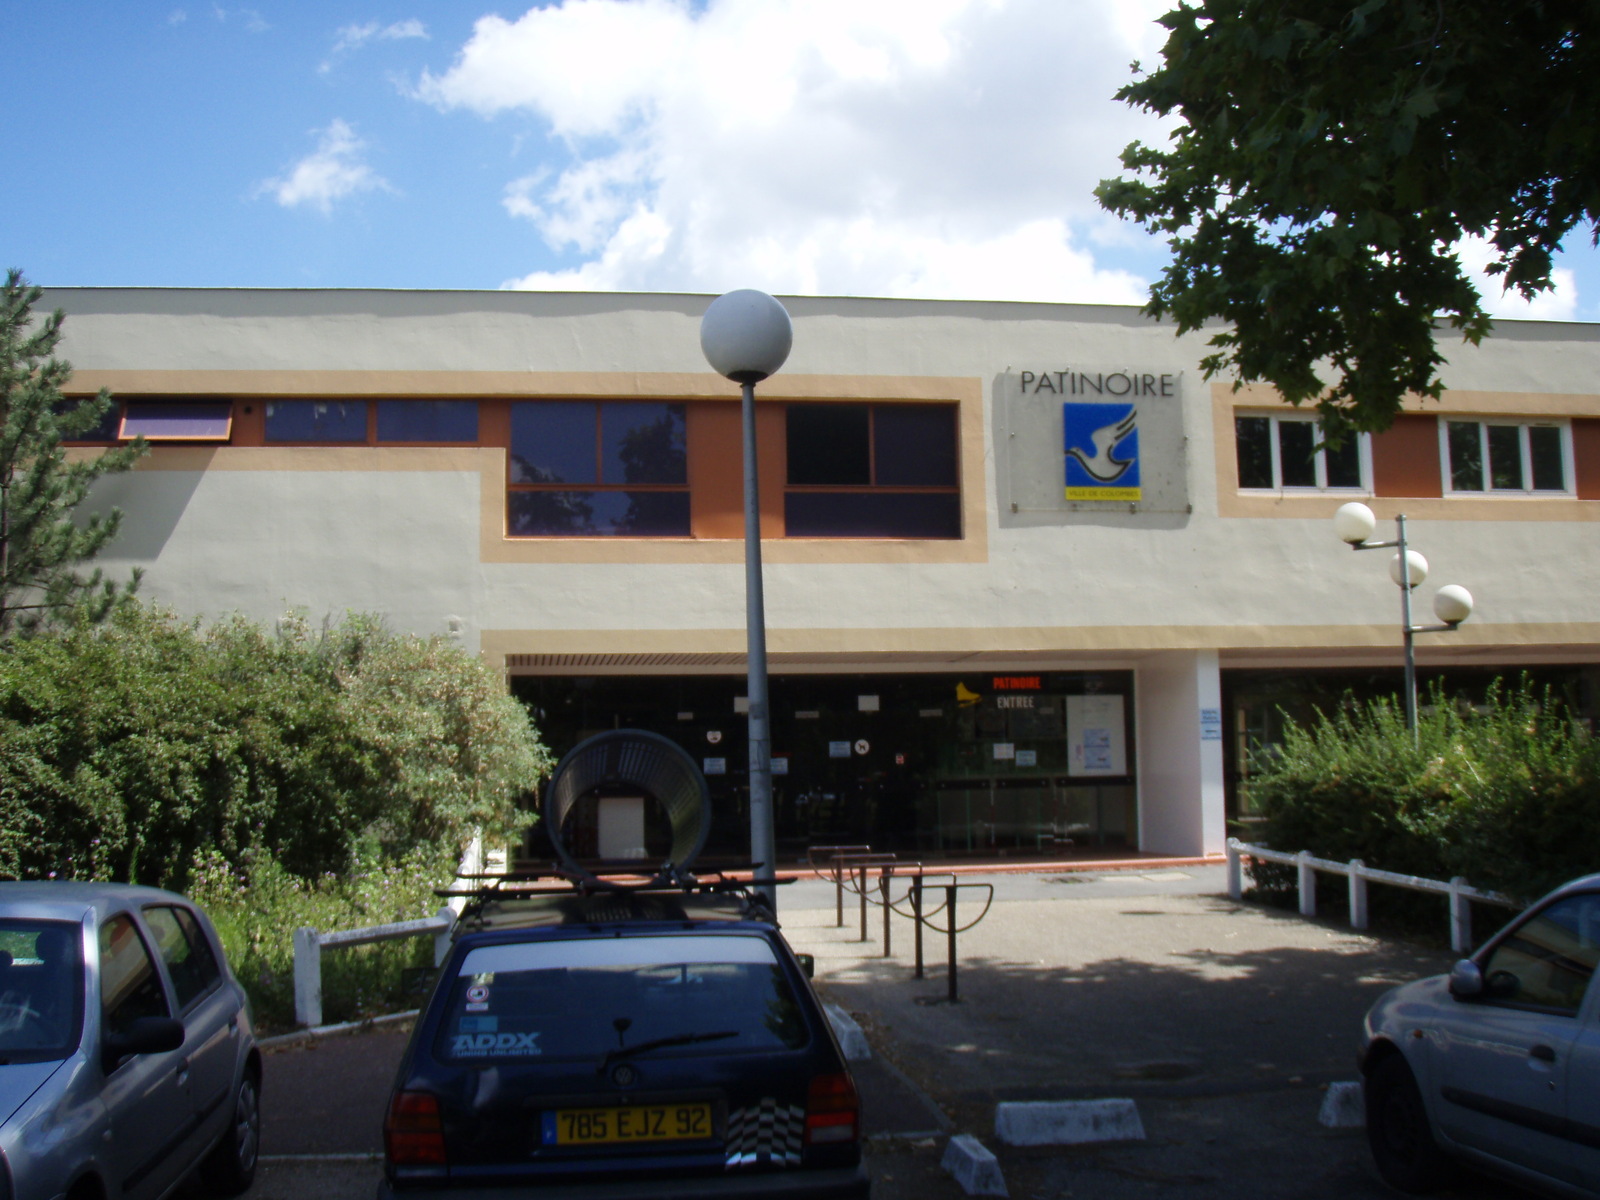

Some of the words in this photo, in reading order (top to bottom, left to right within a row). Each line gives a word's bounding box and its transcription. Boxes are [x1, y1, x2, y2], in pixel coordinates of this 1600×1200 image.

[1021, 371, 1174, 397] PATINOIRE
[1069, 489, 1085, 497] VILLE
[1088, 489, 1097, 497] DE
[992, 676, 1041, 690] PATINOIRE
[451, 1032, 542, 1050] ADDX
[562, 1111, 607, 1140] 785
[617, 1109, 666, 1138] EJZ
[676, 1107, 706, 1135] 92
